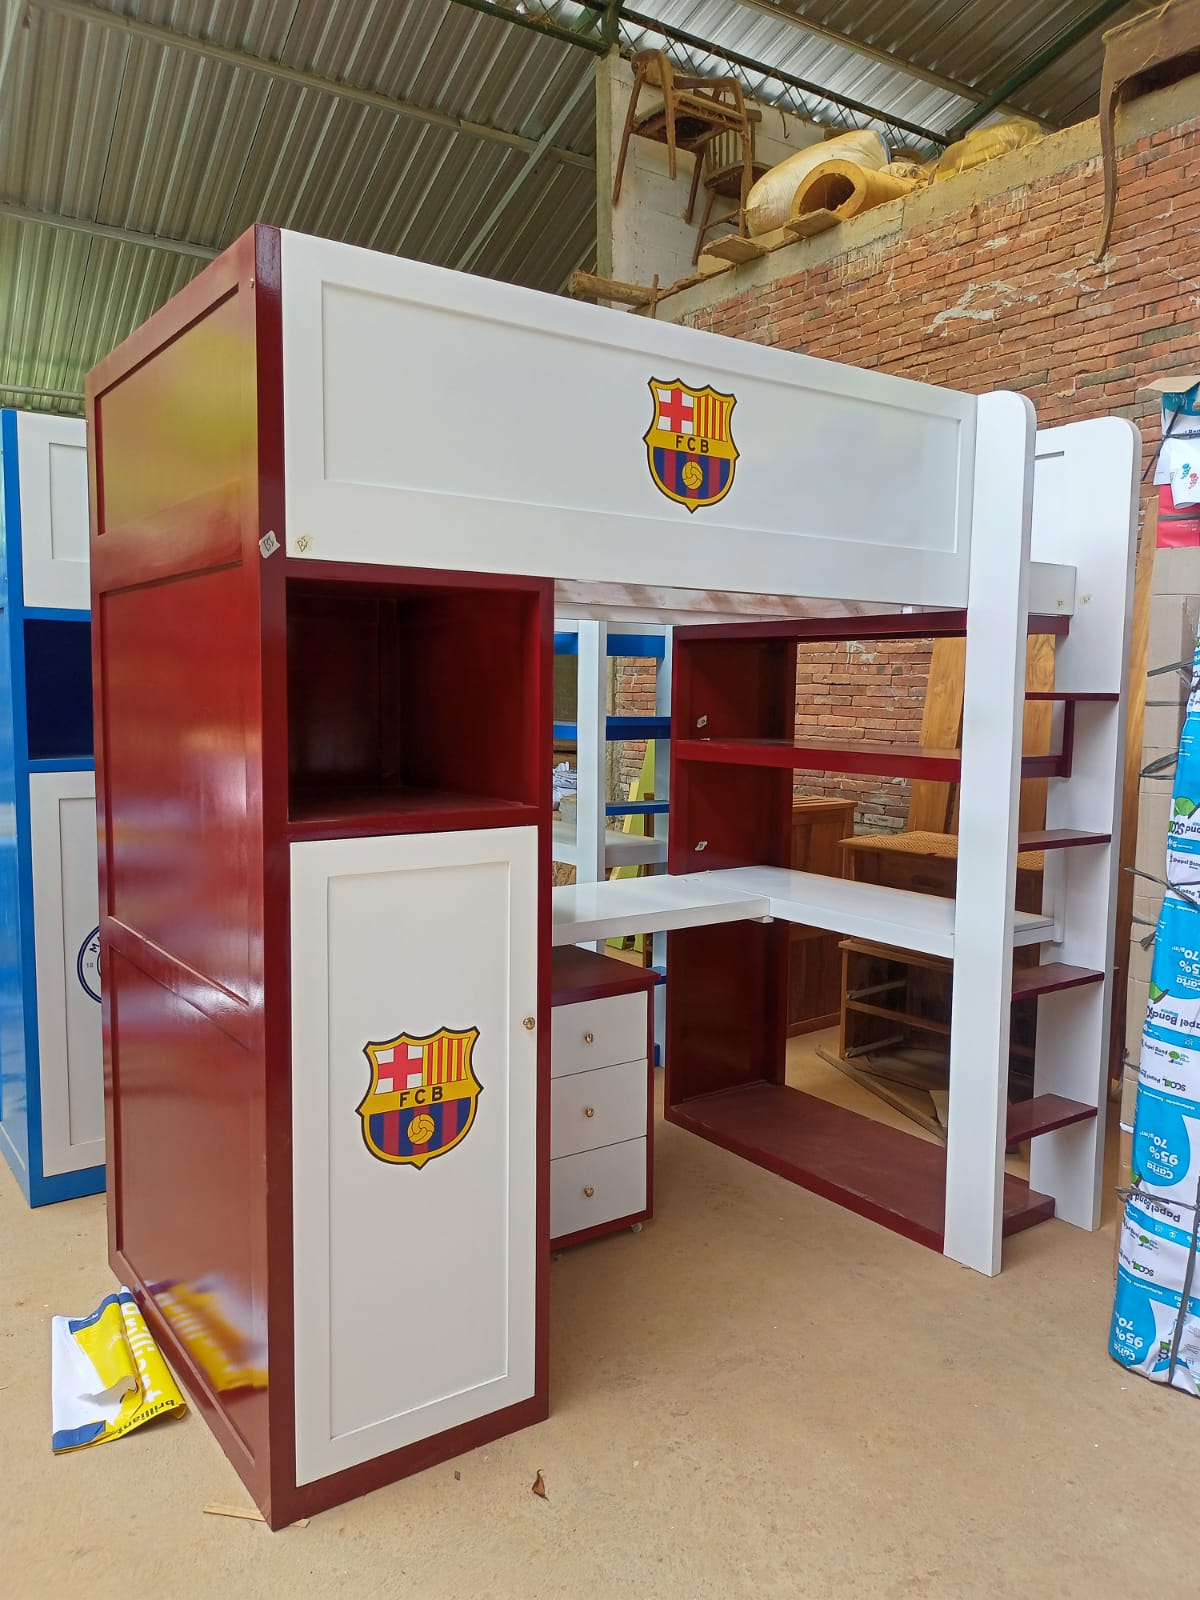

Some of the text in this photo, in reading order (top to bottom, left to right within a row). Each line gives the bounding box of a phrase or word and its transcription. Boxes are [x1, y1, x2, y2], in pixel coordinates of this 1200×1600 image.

[675, 435, 710, 454] FCB
[1179, 960, 1200, 975] 5%
[1176, 976, 1200, 988] arta
[1180, 1018, 1200, 1029] apel
[399, 1086, 444, 1108] FCB
[1149, 1146, 1179, 1166] 95%
[1146, 1161, 1174, 1180] Carta
